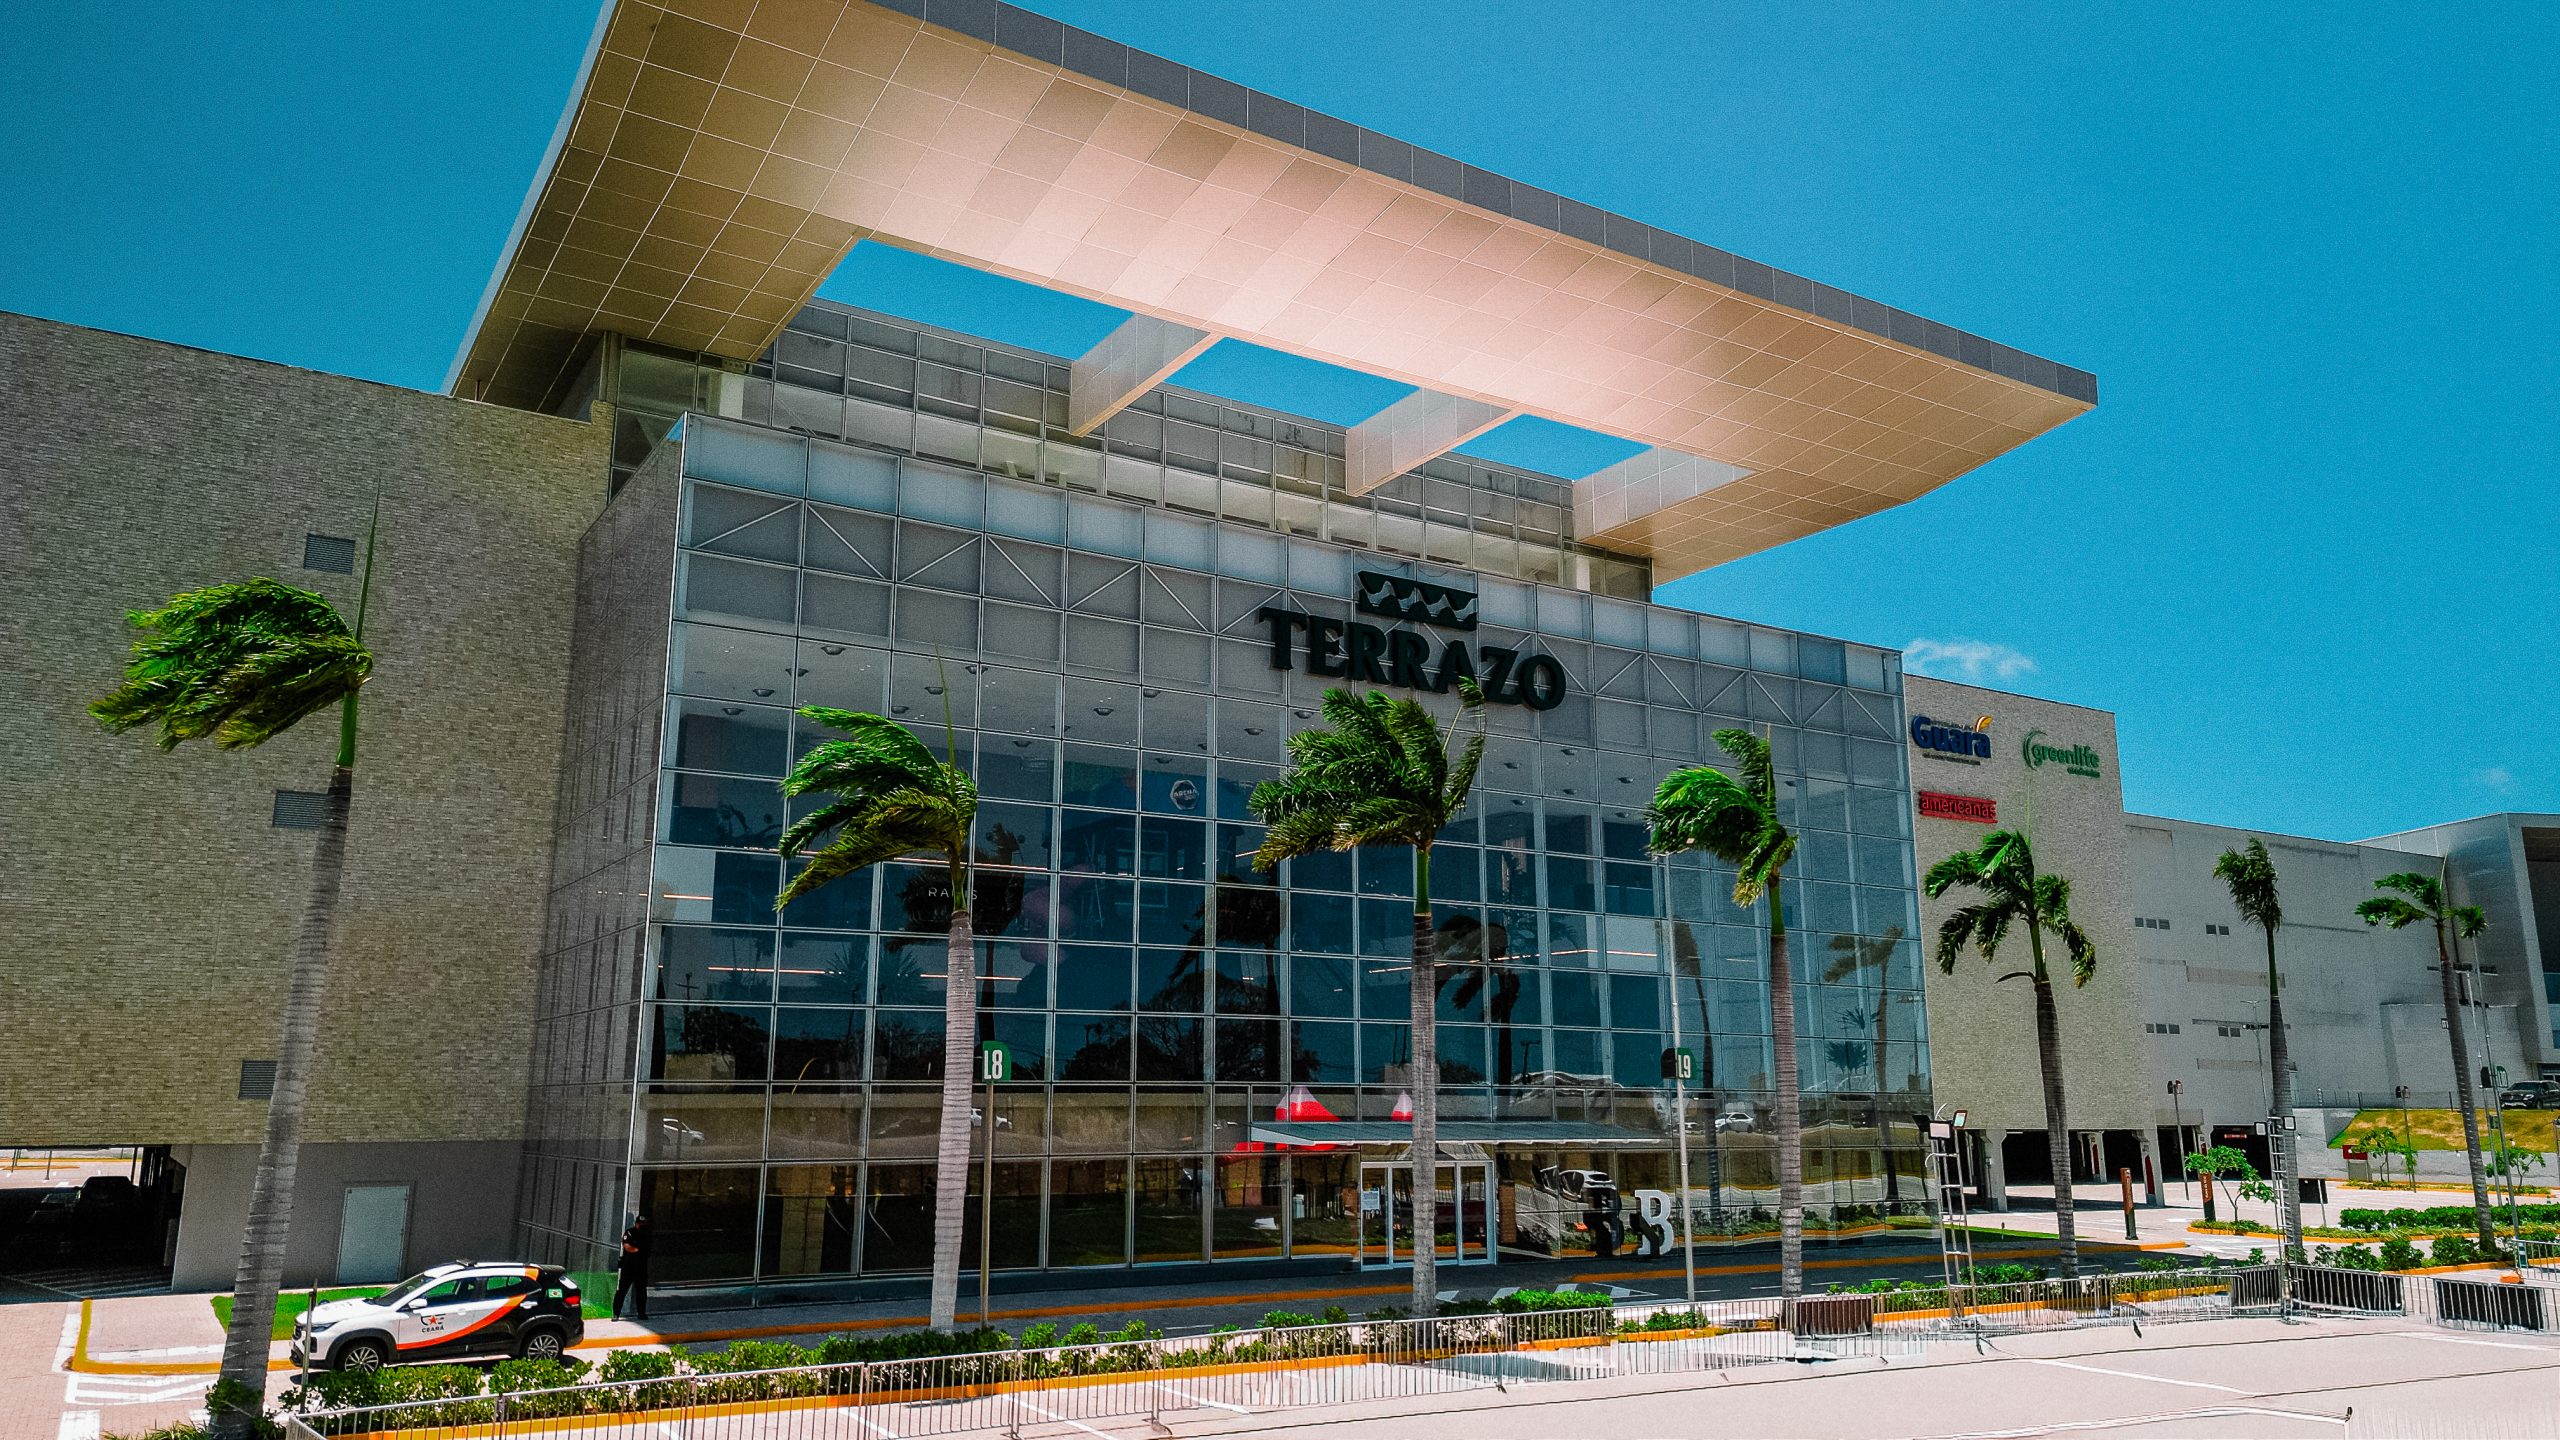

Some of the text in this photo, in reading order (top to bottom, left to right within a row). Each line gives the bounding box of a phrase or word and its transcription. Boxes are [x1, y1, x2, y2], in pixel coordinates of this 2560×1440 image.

[1259, 606, 1567, 711] TERRAZO
[2031, 743, 2100, 768] greenlife
[1921, 797, 1997, 818] americanas
[984, 1049, 1003, 1079] L8
[1677, 1054, 1691, 1078] L9
